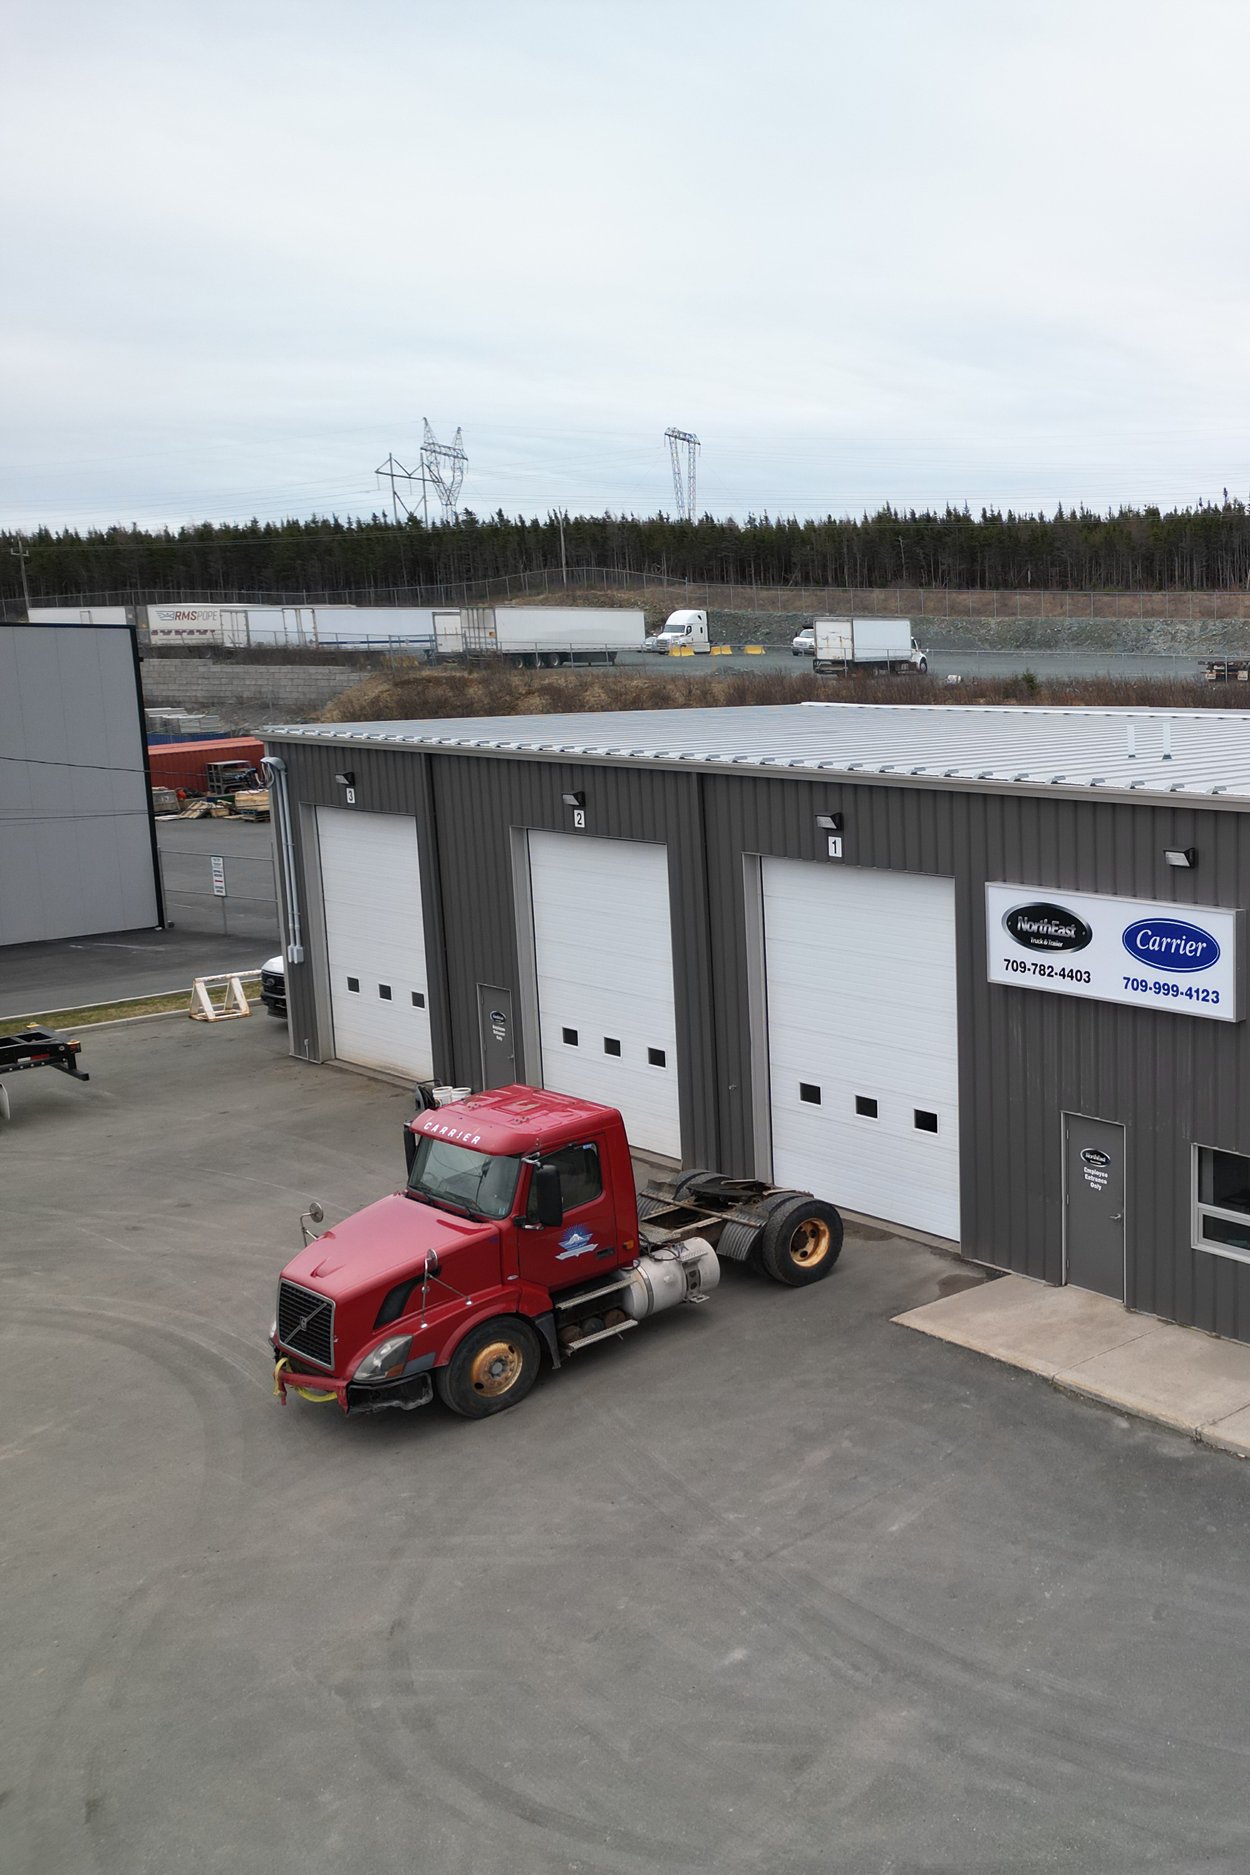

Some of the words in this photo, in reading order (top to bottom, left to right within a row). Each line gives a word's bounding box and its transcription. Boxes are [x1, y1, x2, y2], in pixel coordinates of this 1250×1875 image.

[348, 790, 354, 802] 3
[576, 812, 583, 825] 2
[831, 839, 838, 854] 1
[1017, 916, 1076, 938] NorthEast
[1136, 929, 1207, 957] Carrier
[1003, 958, 1091, 984] 709-782-4403
[1123, 976, 1220, 1004] 709-999-4123
[423, 1121, 480, 1145] CARRIER
